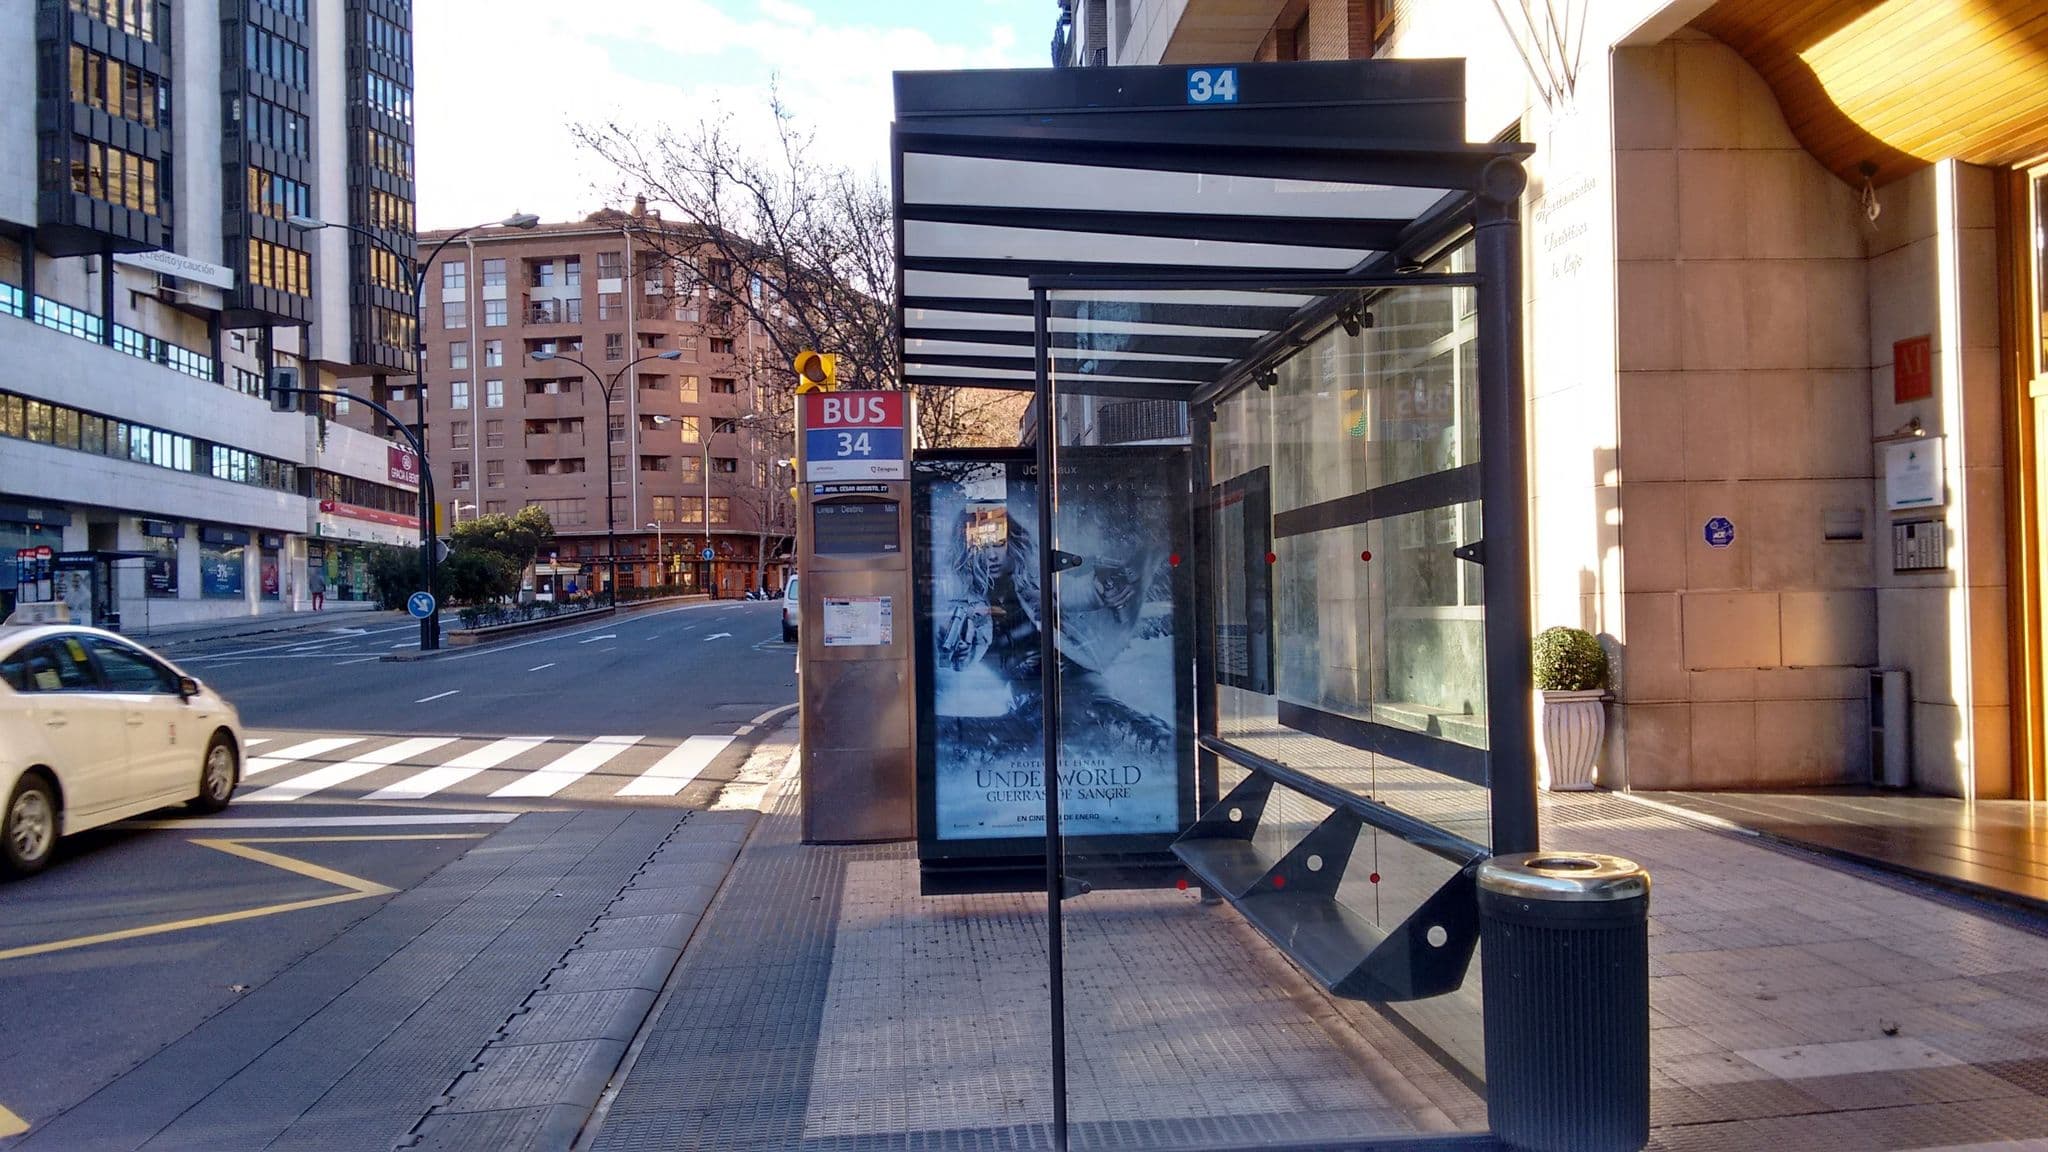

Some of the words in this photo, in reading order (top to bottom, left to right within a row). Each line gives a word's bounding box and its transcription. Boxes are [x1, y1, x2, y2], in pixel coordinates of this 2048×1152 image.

[1189, 70, 1236, 101] 34
[823, 397, 886, 424] BUS
[837, 432, 872, 456] 34
[976, 765, 1142, 788] UNDEWORLD
[1077, 787, 1131, 806] SANGRE
